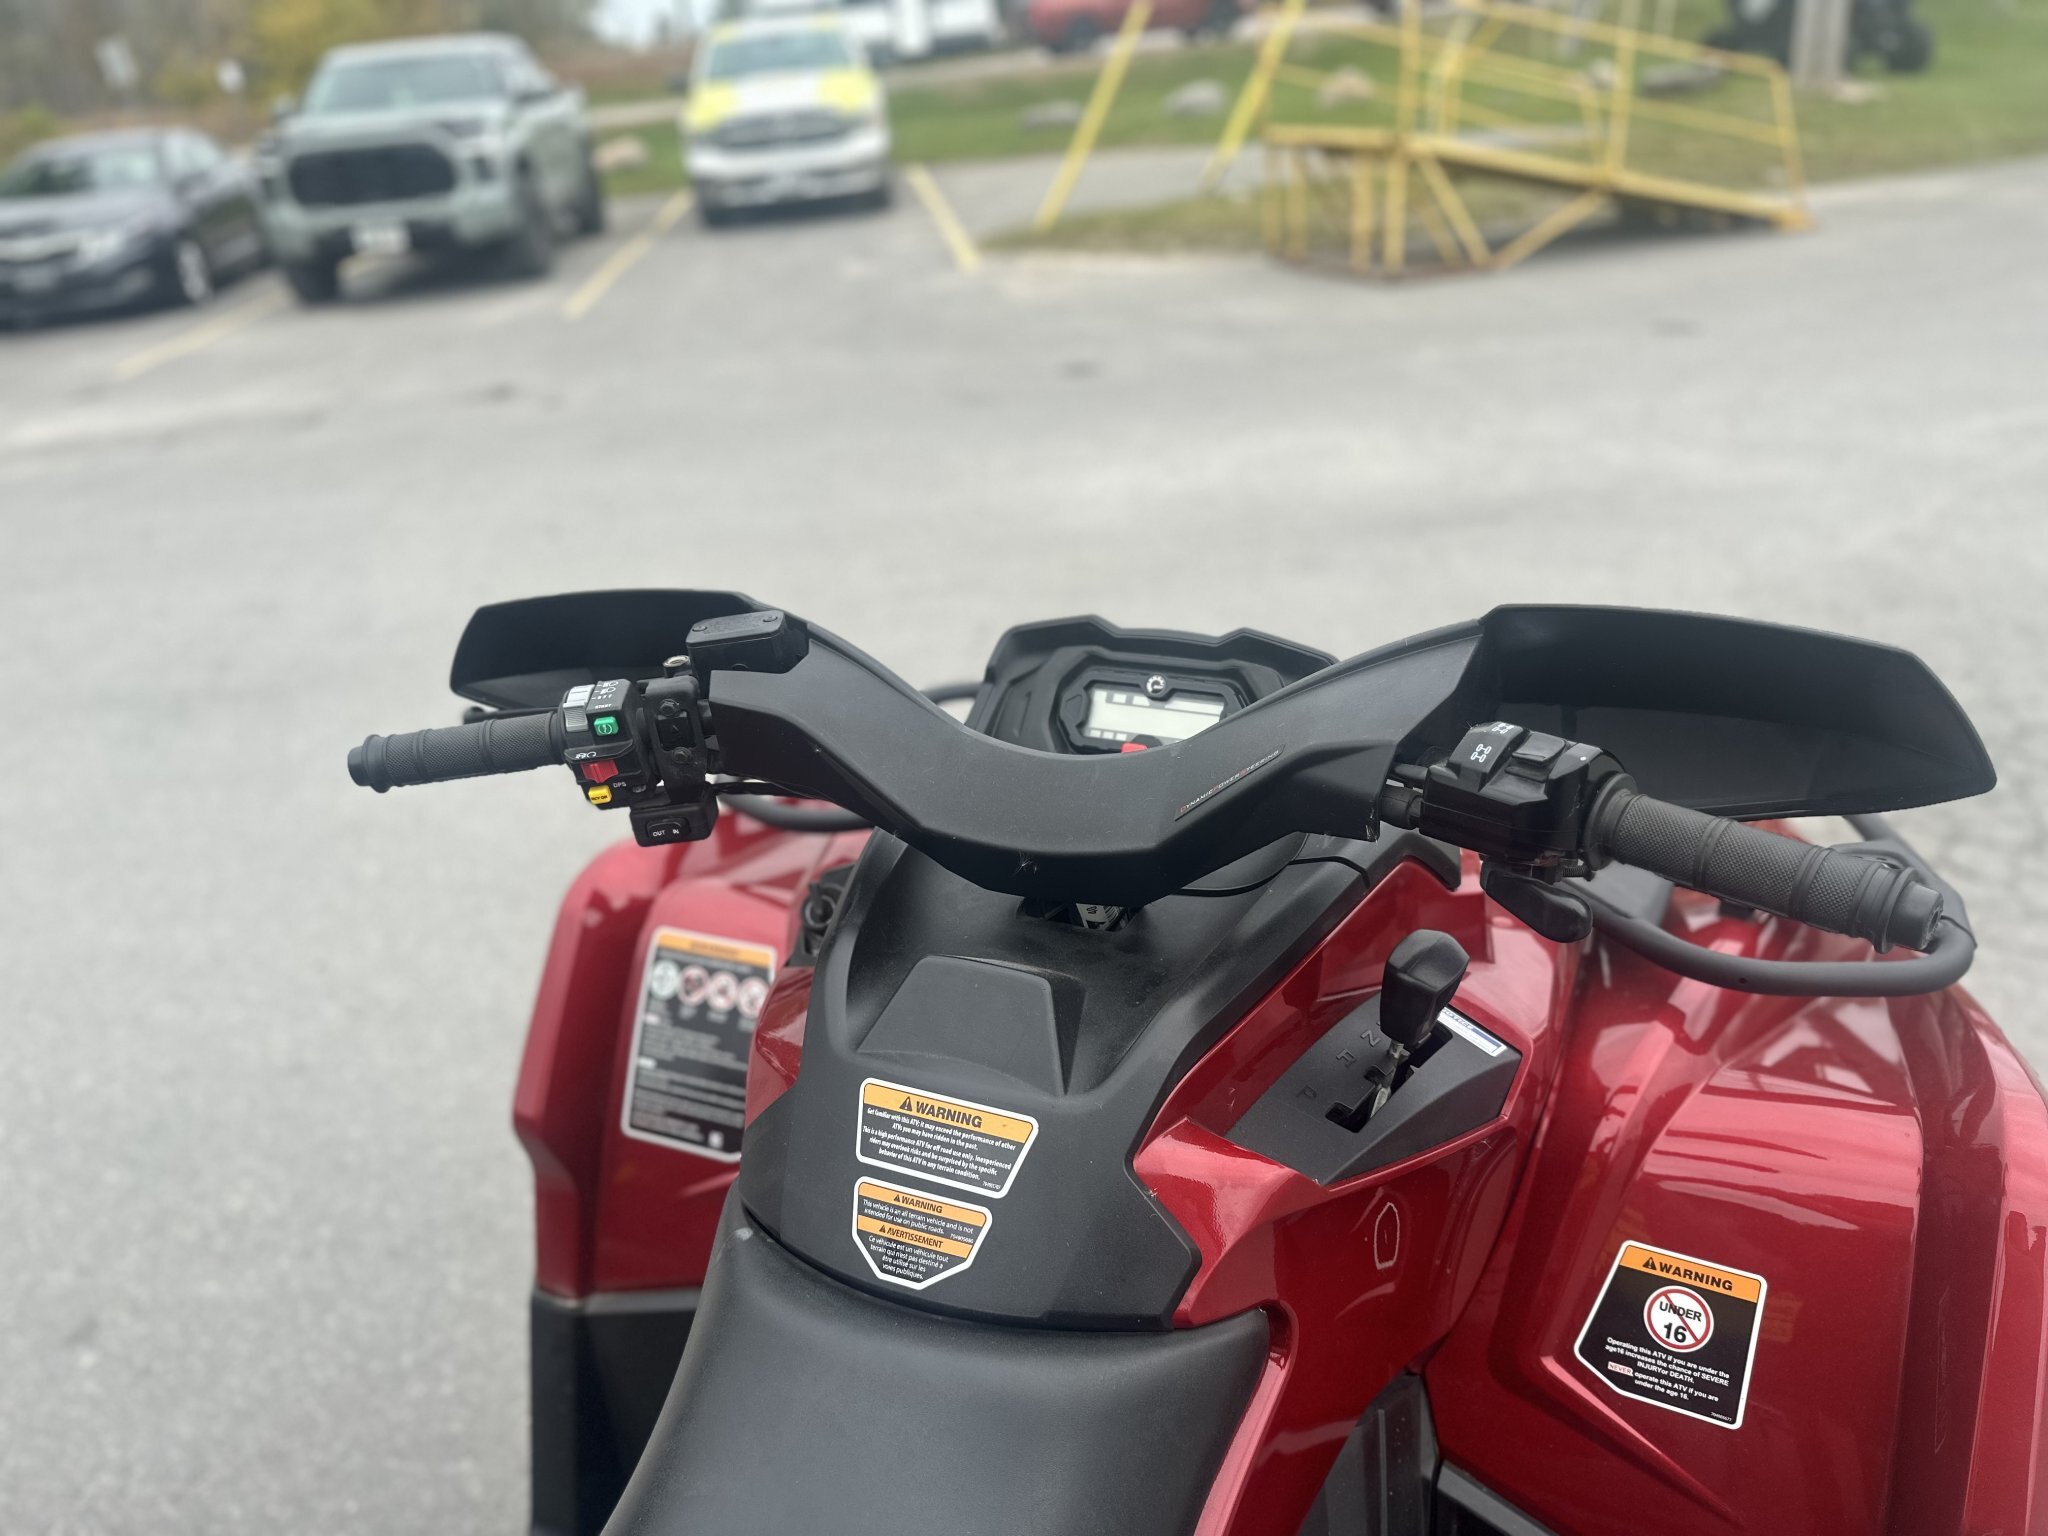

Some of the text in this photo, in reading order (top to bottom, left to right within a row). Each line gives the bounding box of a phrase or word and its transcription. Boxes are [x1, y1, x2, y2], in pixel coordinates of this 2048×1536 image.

[1180, 750, 1279, 812] DYNAMIC POWER STEERING
[916, 1100, 982, 1128] WARNING
[874, 1109, 890, 1119] familiar
[890, 1113, 900, 1122] with
[901, 1116, 909, 1124] this
[925, 1122, 935, 1132] may
[936, 1125, 952, 1135] exceed
[953, 1129, 961, 1138] the
[962, 1131, 994, 1146] performance
[1001, 1142, 1016, 1152] other
[892, 1122, 902, 1131] ATVs
[902, 1125, 911, 1135] you
[911, 1127, 921, 1137] may
[922, 1130, 933, 1139] have
[933, 1133, 949, 1143] ridden
[956, 1139, 964, 1147] the
[965, 1141, 978, 1152] past.
[869, 1136, 881, 1146] riders
[882, 1139, 891, 1149] may
[891, 1142, 910, 1153] overlook
[910, 1146, 921, 1156] risks
[922, 1150, 931, 1158] and
[938, 1154, 962, 1166] surprised
[962, 1160, 968, 1169] by
[969, 1162, 978, 1171] the
[978, 1164, 997, 1177] specific
[878, 1129, 888, 1140] high
[887, 1132, 915, 1145] performance
[916, 1139, 925, 1148] ATV
[941, 1146, 952, 1155] road
[962, 1151, 974, 1162] only.
[975, 1154, 1012, 1170] Inexperienced
[878, 1147, 897, 1159] behavior
[903, 1153, 912, 1162] this
[912, 1156, 922, 1165] ATV
[927, 1160, 937, 1170] any
[937, 1162, 954, 1173] terrain
[955, 1167, 980, 1180] condition.
[864, 1199, 872, 1208] This
[873, 1202, 889, 1212] vehicle
[909, 1211, 925, 1222] terrain
[927, 1216, 945, 1227] vehicle
[946, 1221, 957, 1230] and
[964, 1225, 974, 1234] not
[902, 1195, 942, 1213] WARNING
[864, 1207, 885, 1220] intended
[910, 1219, 927, 1232] public
[928, 1224, 944, 1235] roads.
[869, 1235, 875, 1244] Ce
[876, 1237, 896, 1249] véhicule
[913, 1246, 936, 1260] véhicule
[937, 1252, 949, 1263] tout
[887, 1227, 944, 1249] AVERTISSEMENT
[870, 1244, 886, 1254] terrain
[887, 1248, 895, 1258] qui
[908, 1256, 918, 1264] pas
[883, 1263, 924, 1280] voies publiques.
[1659, 1262, 1733, 1292] WARNING
[1659, 1301, 1702, 1322] UNDER
[1663, 1322, 1687, 1344] 16
[1607, 1337, 1638, 1352] Operating
[1639, 1346, 1651, 1355] this
[1653, 1350, 1666, 1360] ATV
[1673, 1357, 1686, 1367] you
[1698, 1365, 1718, 1376] under
[1719, 1370, 1730, 1379] the
[1625, 1350, 1656, 1364] increases
[1657, 1359, 1667, 1368] the
[1668, 1363, 1692, 1375] chance
[1701, 1373, 1729, 1387] SEVERE
[1610, 1363, 1632, 1374] NEVER
[1635, 1372, 1659, 1384] operate
[1660, 1379, 1672, 1388] this
[1673, 1382, 1688, 1393] ATV
[1694, 1390, 1707, 1400] you
[1708, 1394, 1719, 1402] are
[1635, 1379, 1654, 1389] under
[1655, 1385, 1665, 1393] the
[1666, 1389, 1678, 1398] age
[1670, 1370, 1694, 1384] DEATH.
